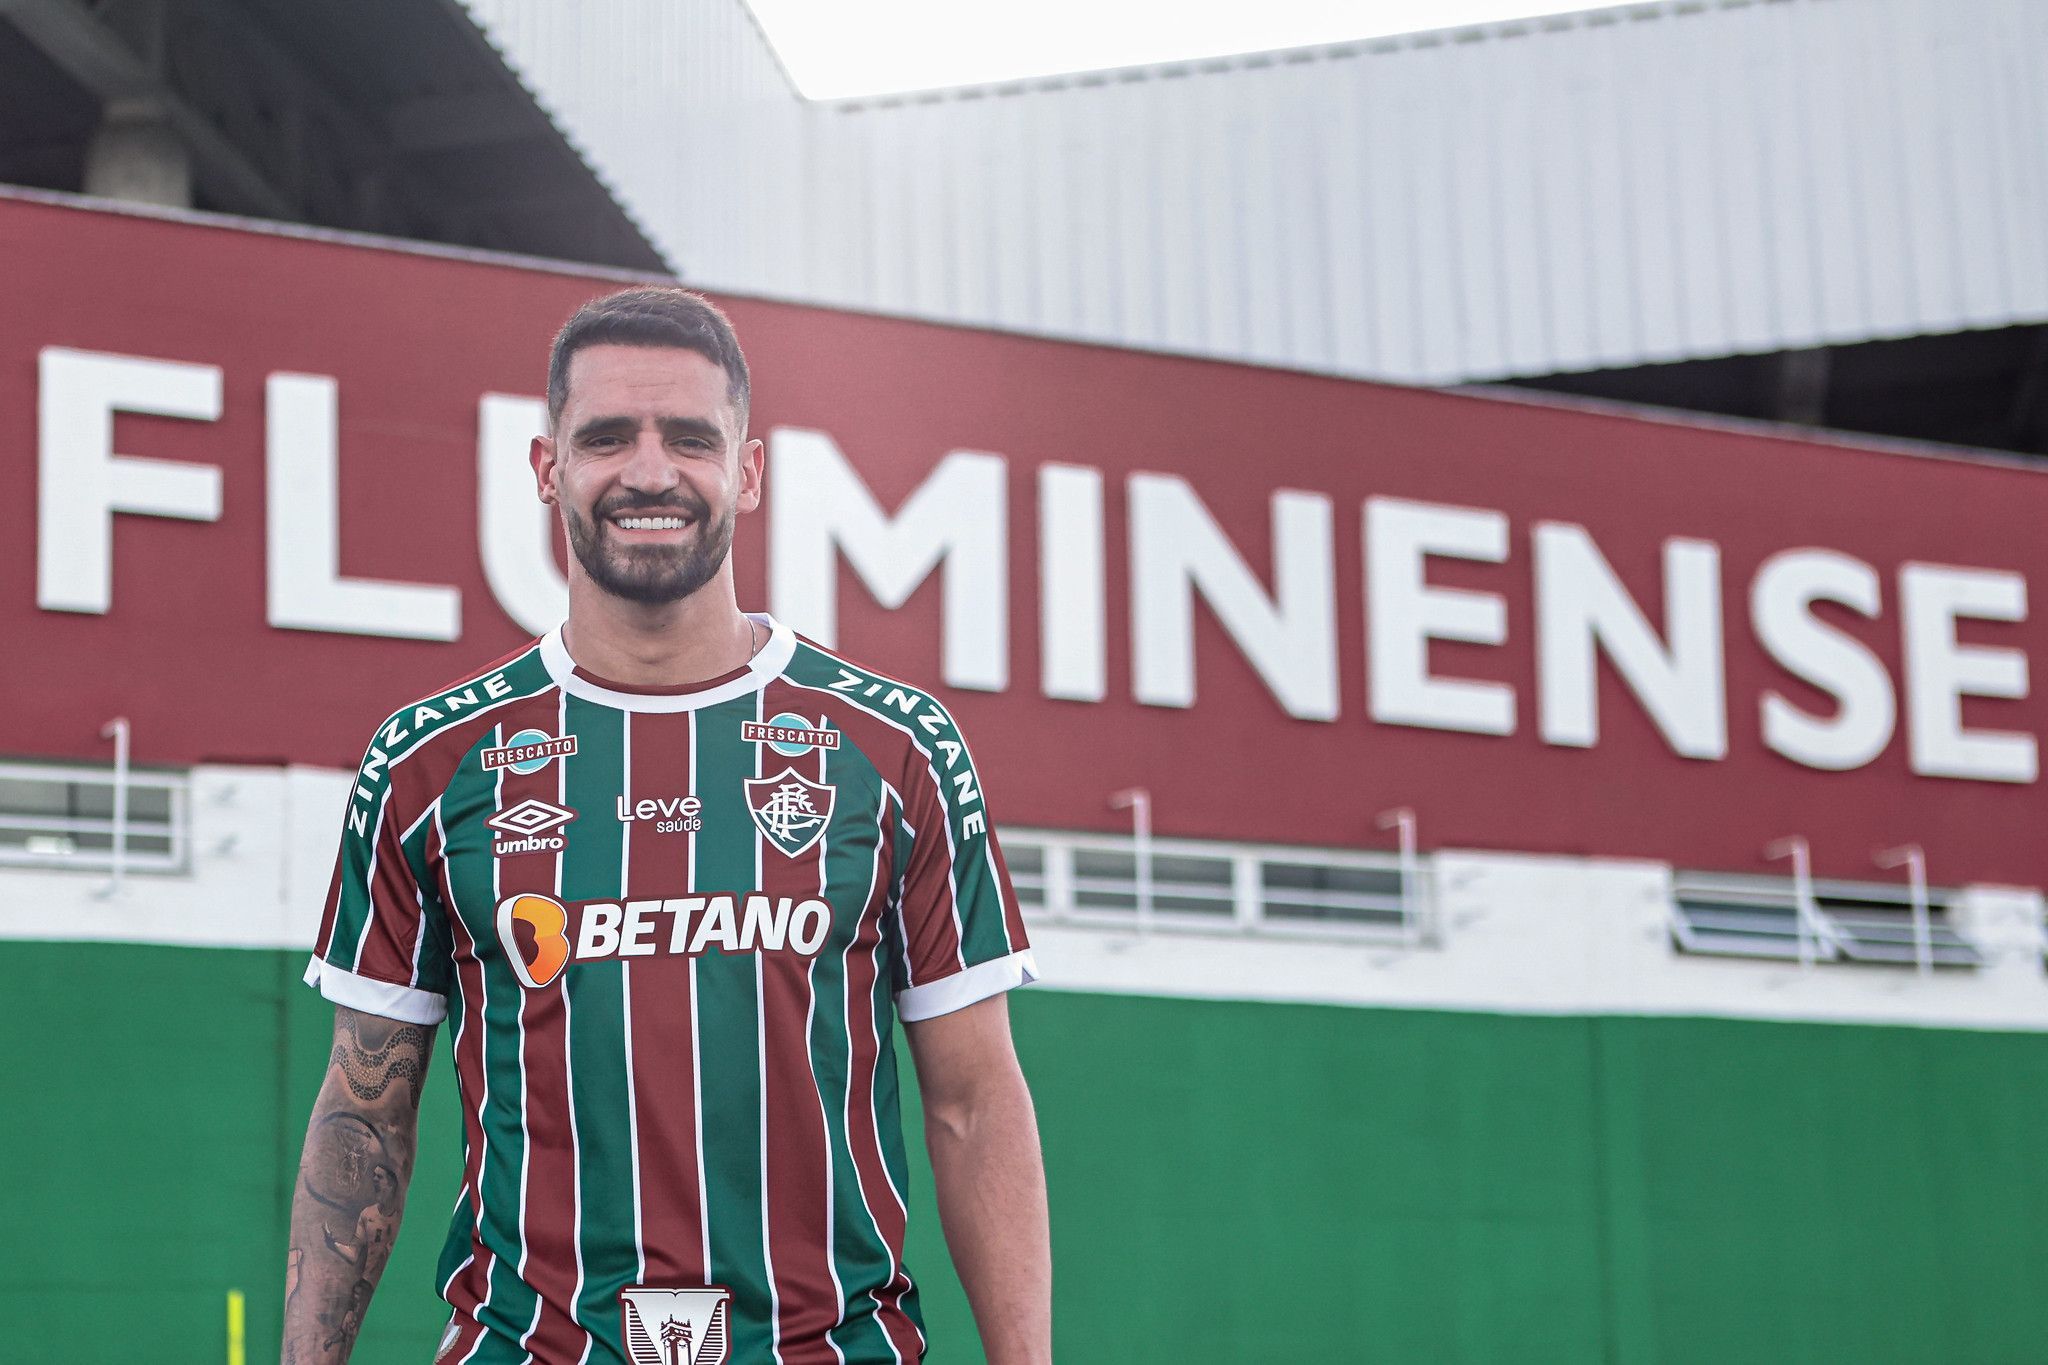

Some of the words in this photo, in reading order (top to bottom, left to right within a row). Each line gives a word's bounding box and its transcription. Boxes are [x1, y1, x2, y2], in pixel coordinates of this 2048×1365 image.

[747, 726, 835, 746] FRESCATTO
[347, 672, 513, 838] ZINZANE
[487, 740, 572, 766] FRESCATTO
[827, 668, 987, 841] ZINZANE
[617, 795, 702, 821] Leve
[656, 816, 702, 833] saúde
[495, 835, 564, 855] umbro
[575, 896, 831, 959] BETANO
